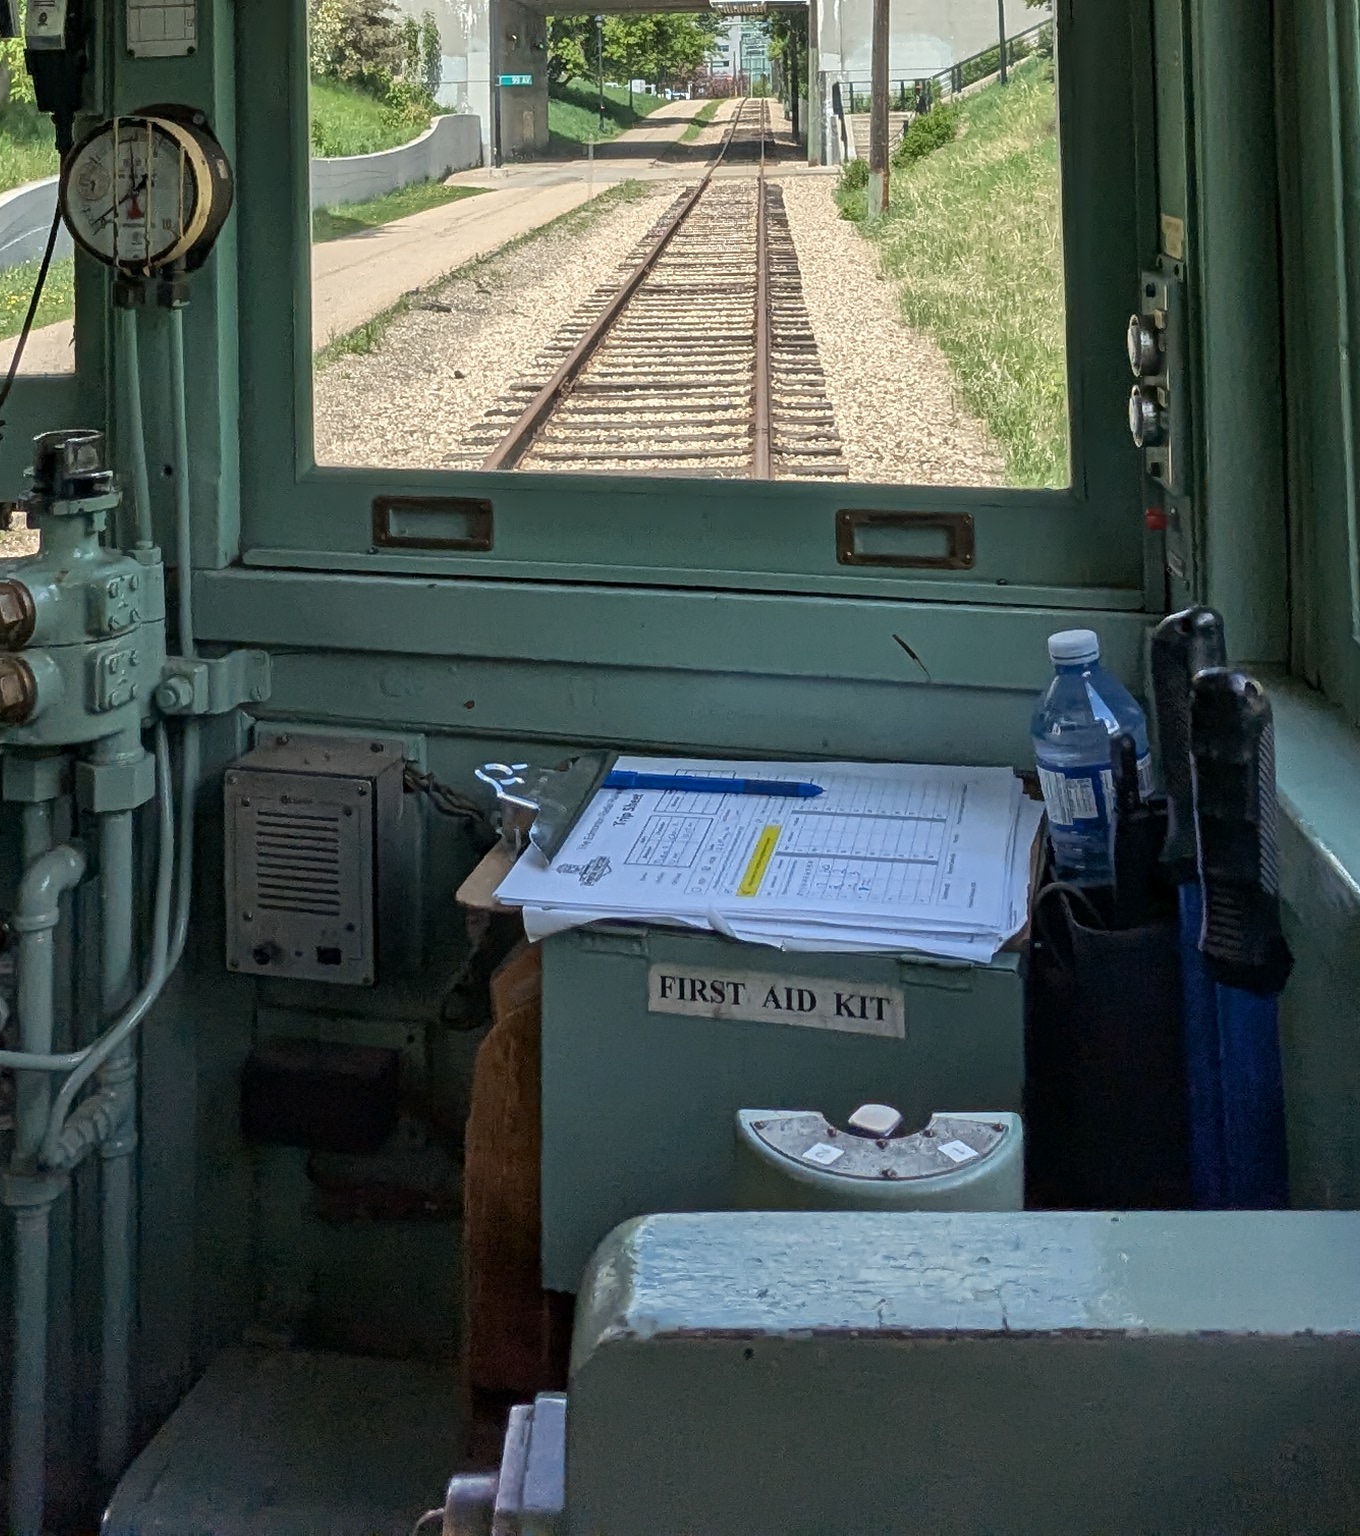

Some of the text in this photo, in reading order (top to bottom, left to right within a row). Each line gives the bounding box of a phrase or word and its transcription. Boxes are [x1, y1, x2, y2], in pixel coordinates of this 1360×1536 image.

[612, 812, 635, 827] Trip
[659, 975, 892, 1022] FIRST AID KIT
